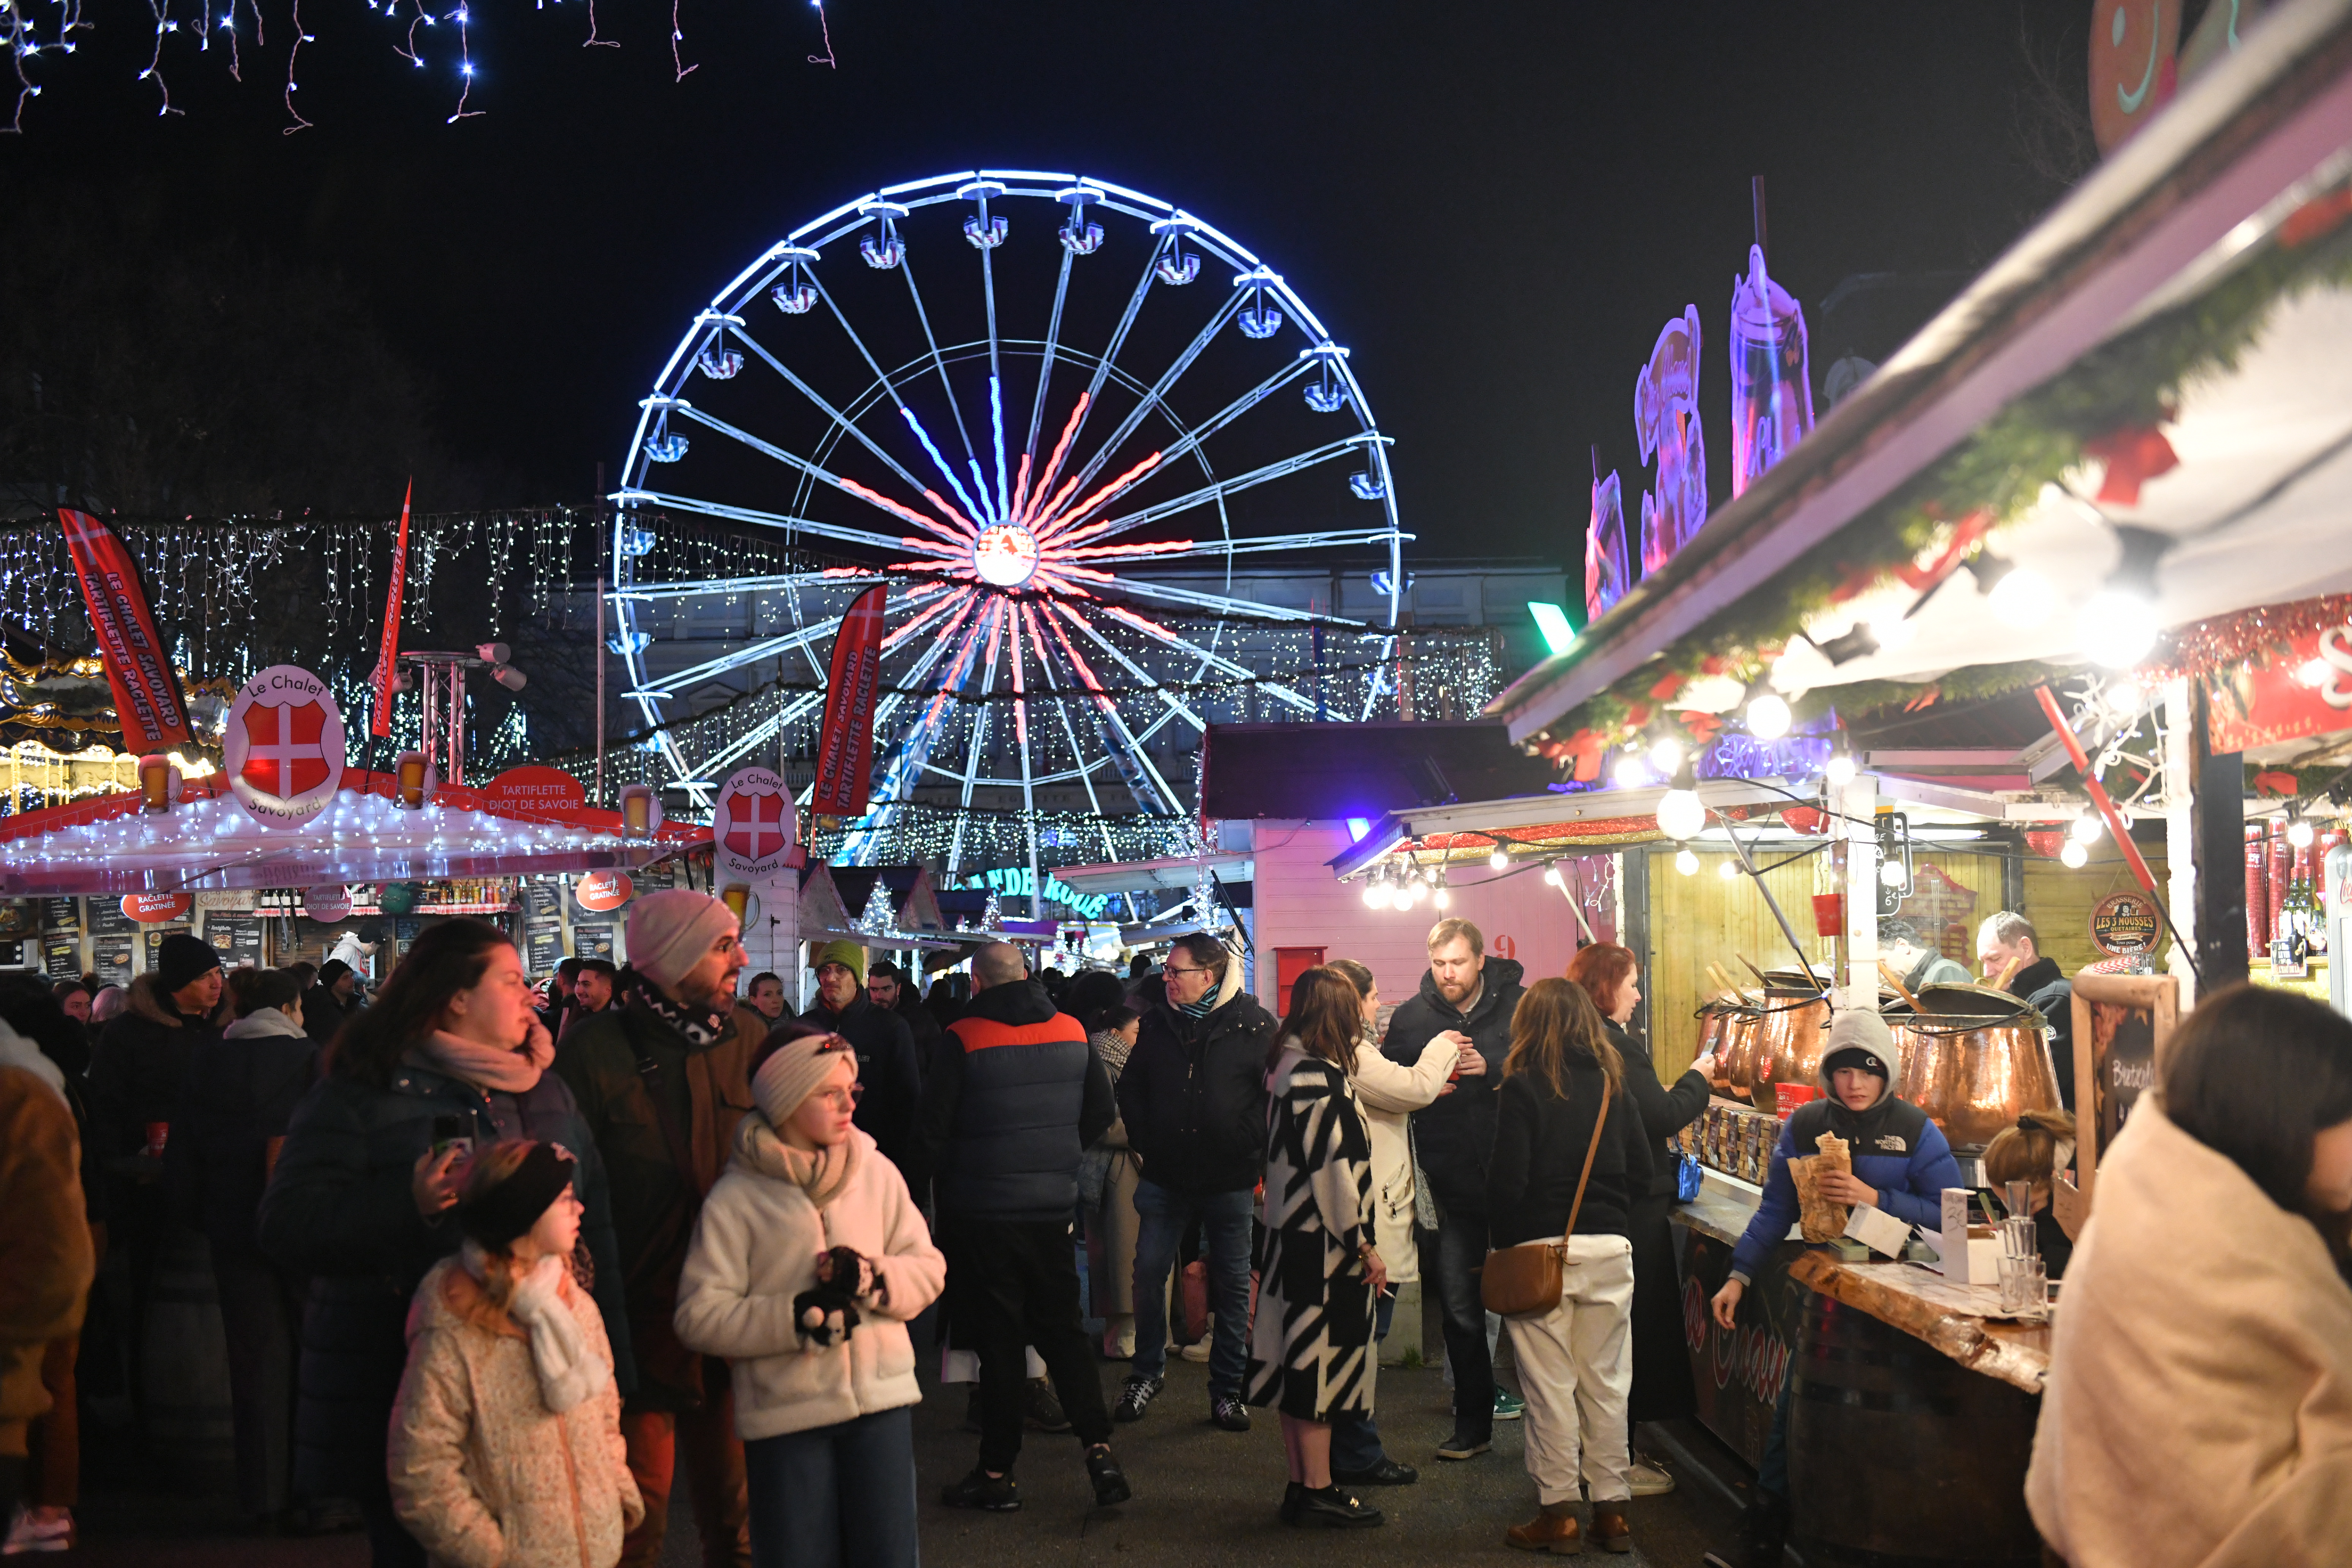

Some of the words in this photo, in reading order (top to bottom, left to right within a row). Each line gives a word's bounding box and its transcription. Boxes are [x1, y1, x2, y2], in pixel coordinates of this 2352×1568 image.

[388, 543, 403, 624] RACLETTE
[84, 572, 131, 665] TARTIFLETTE
[122, 667, 163, 741] RACLETTE
[106, 572, 122, 590] LE
[116, 595, 149, 649] CHALET
[138, 654, 180, 727] SAVOYARD
[248, 684, 266, 698] Le
[272, 675, 324, 697] Chalet
[837, 651, 858, 722] SAVOYARD
[837, 718, 864, 809] TARTIFLETTE
[854, 646, 877, 717] RACLETTE
[823, 726, 842, 779] CHALET
[502, 785, 566, 795] TARTIFLETTE
[731, 779, 744, 789] Le
[747, 773, 784, 790] Chalet
[819, 780, 832, 800] LE
[249, 797, 322, 820] Savoyard
[489, 800, 517, 811] DIOT
[520, 799, 535, 809] DE
[538, 798, 579, 809] SAVOIE
[728, 858, 779, 875] Savoyard
[139, 901, 176, 912] GRATINÉE
[2107, 897, 2143, 909] BRASSERIE
[2096, 918, 2110, 929] LES
[2112, 917, 2116, 926] 3
[1494, 935, 1516, 961] 9
[2106, 943, 2120, 953] UNE
[2122, 945, 2143, 954] BIÈRE
